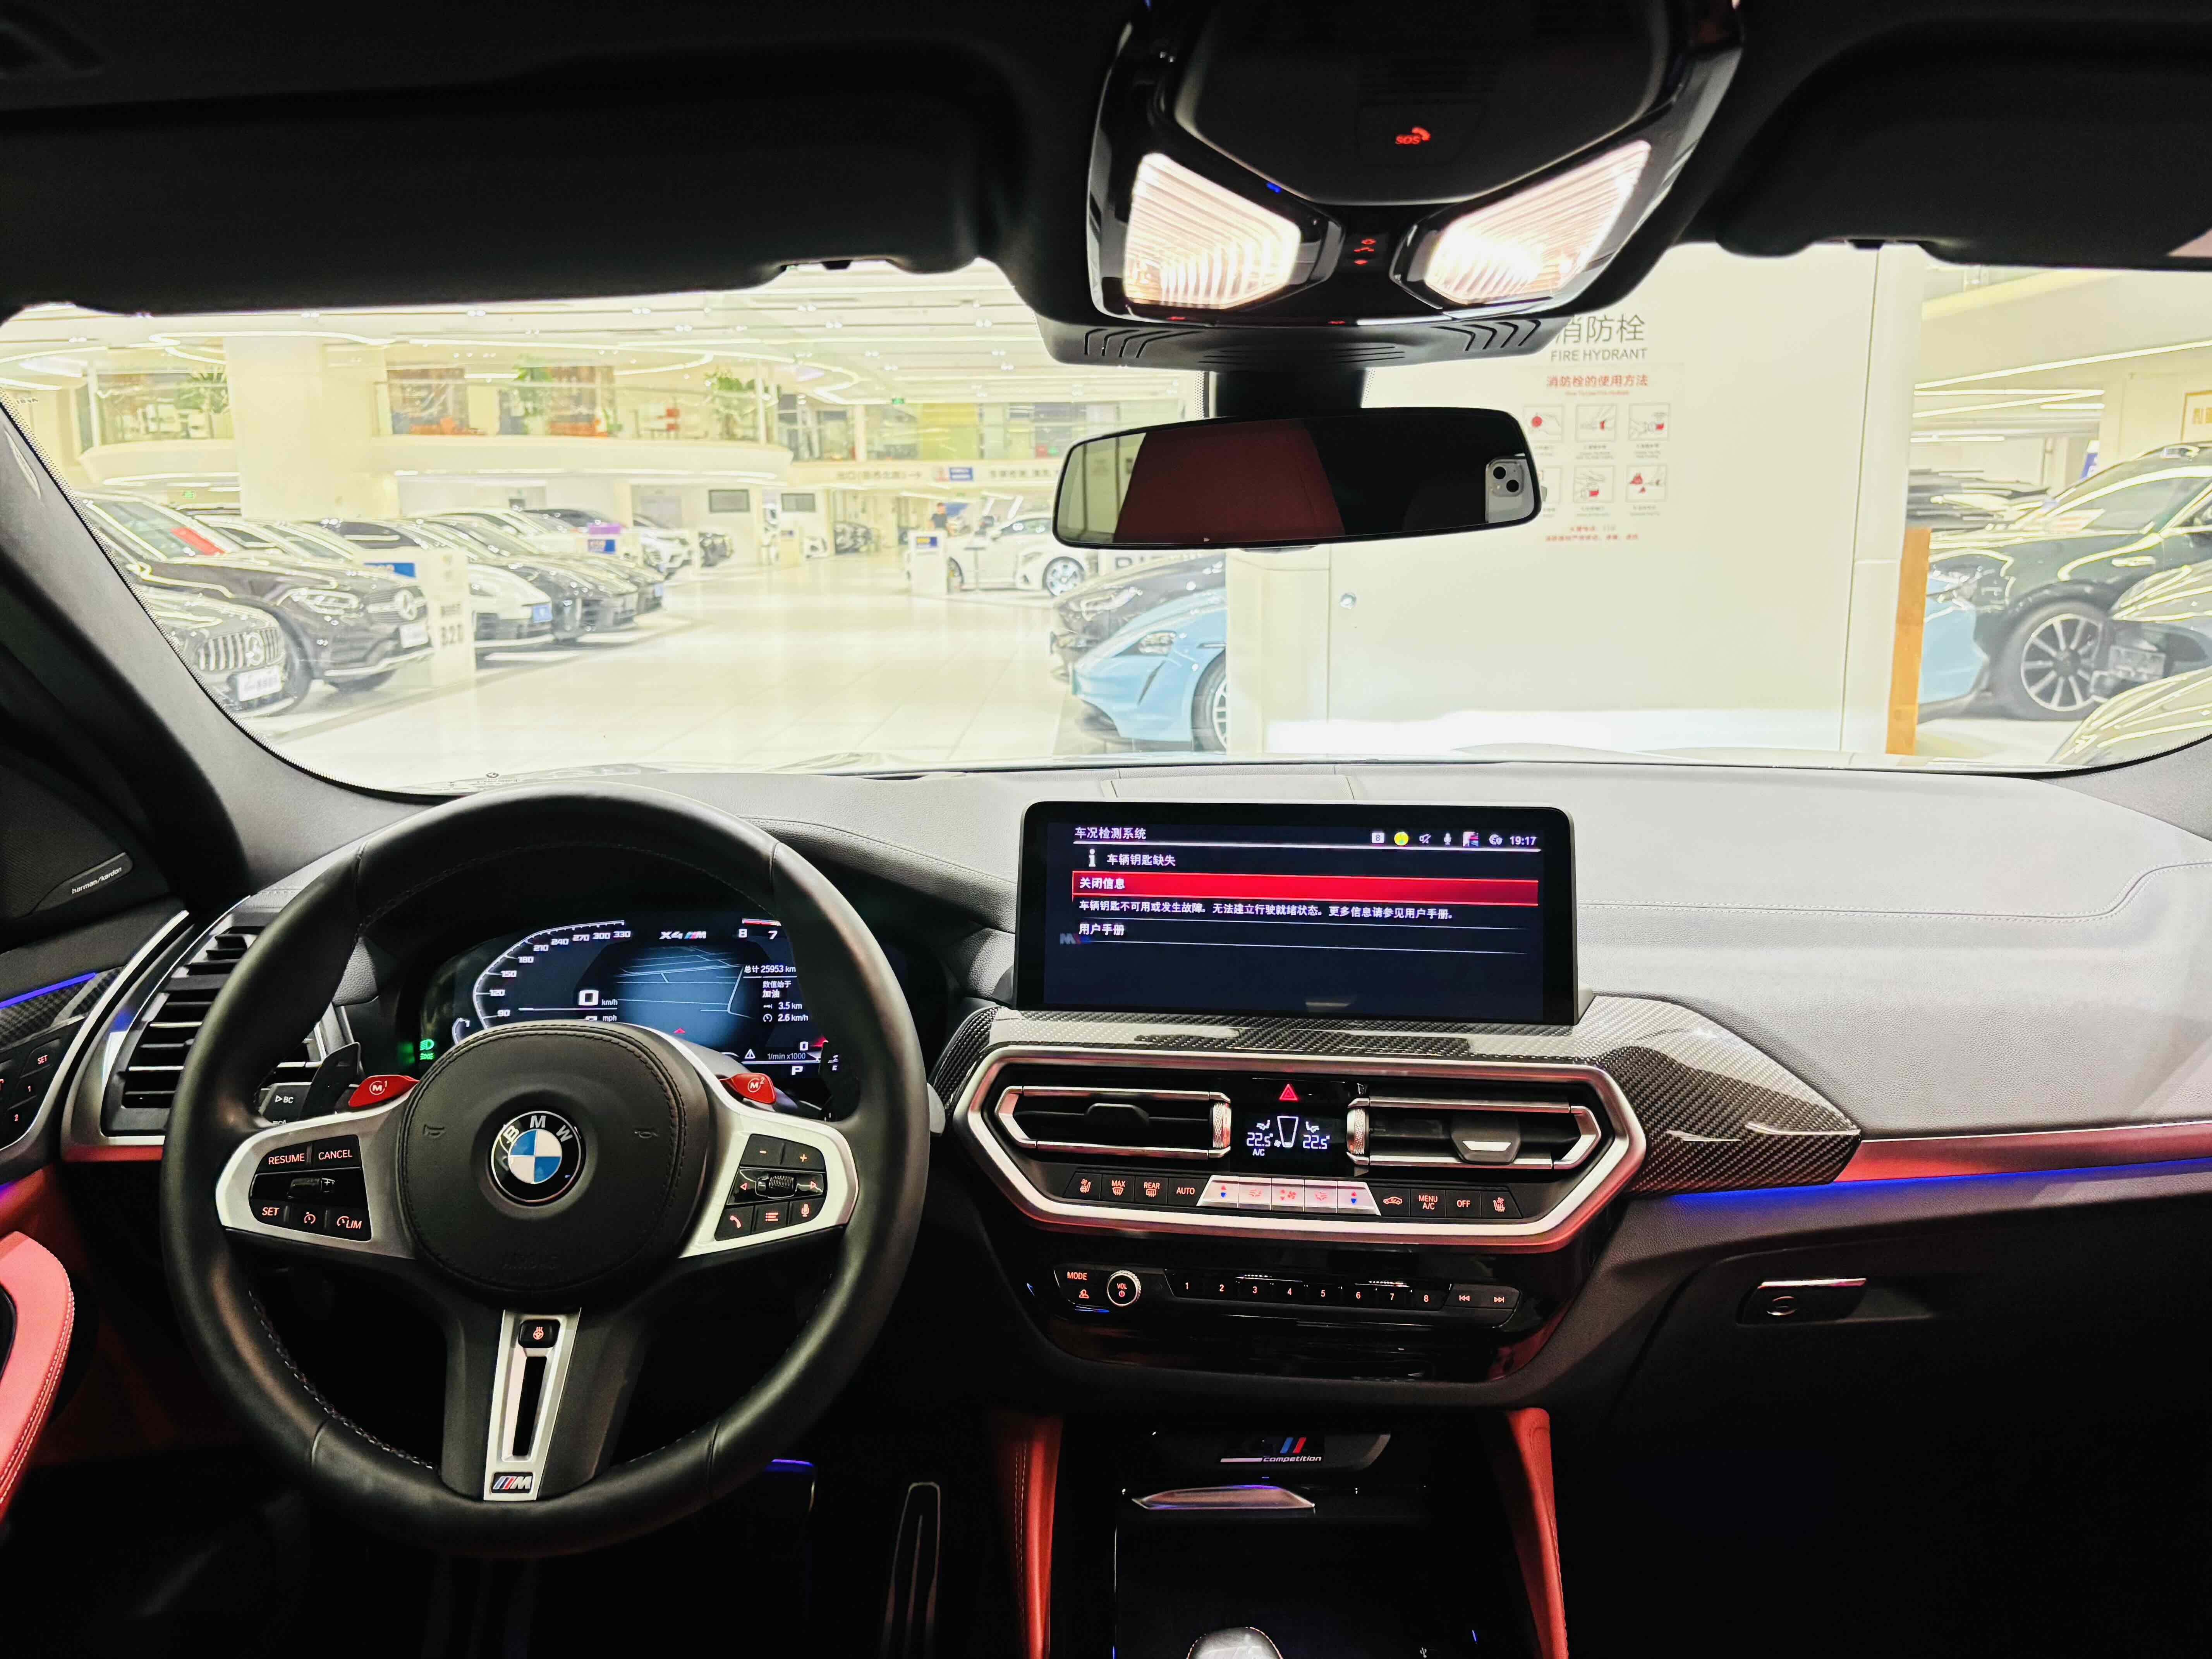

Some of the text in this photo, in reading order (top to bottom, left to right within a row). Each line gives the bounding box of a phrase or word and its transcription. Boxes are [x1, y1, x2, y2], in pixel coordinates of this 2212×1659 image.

[1395, 135, 1420, 145] SOS
[1556, 314, 1645, 344] 消防栓
[1551, 347, 1648, 362] FIRE HYDRANT
[1075, 827, 1146, 839] 车况检测系统
[1510, 836, 1537, 845] 19:17
[1107, 854, 1176, 866] 车辆钥匙缺失
[1079, 877, 1125, 889] 关闭信息
[1079, 923, 1125, 935] 用户手册
[659, 931, 683, 939] X4
[768, 930, 778, 939] 7
[579, 990, 599, 1006] 0
[762, 989, 780, 998] 加油
[800, 1041, 809, 1051] 0
[37, 1054, 48, 1065] SET
[791, 1066, 804, 1075] P
[503, 1115, 573, 1144] BMW
[268, 1153, 305, 1165] RESUME
[318, 1149, 353, 1160] CANCEL
[1176, 1187, 1195, 1195] AUTO
[1422, 1202, 1435, 1210] A/C
[1456, 1200, 1470, 1208] OFF
[262, 1207, 280, 1216] SET
[346, 1220, 362, 1229] LIM
[1067, 1271, 1087, 1280] MODE
